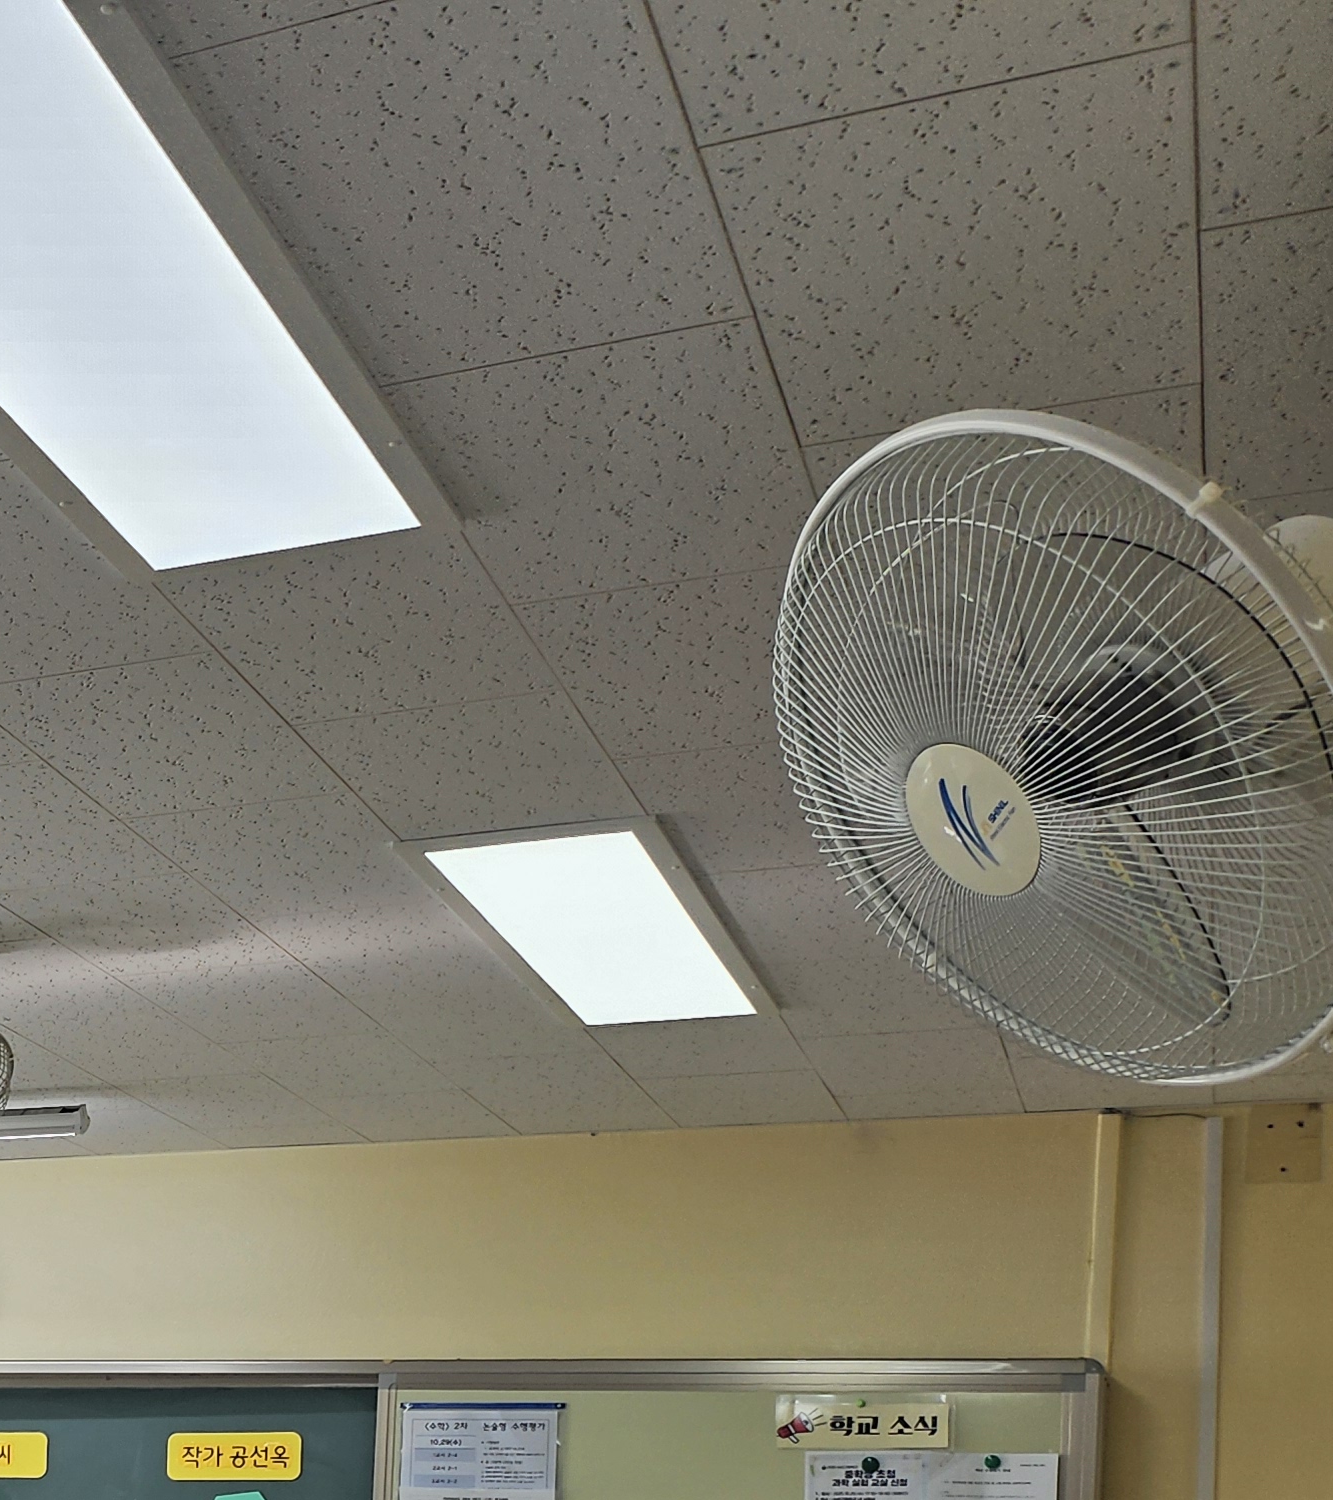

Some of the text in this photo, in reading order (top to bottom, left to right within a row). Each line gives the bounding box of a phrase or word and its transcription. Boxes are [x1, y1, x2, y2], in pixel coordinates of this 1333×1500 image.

[830, 1416, 938, 1436] 학교 소식
[182, 1445, 290, 1468] 작가 공선옥
